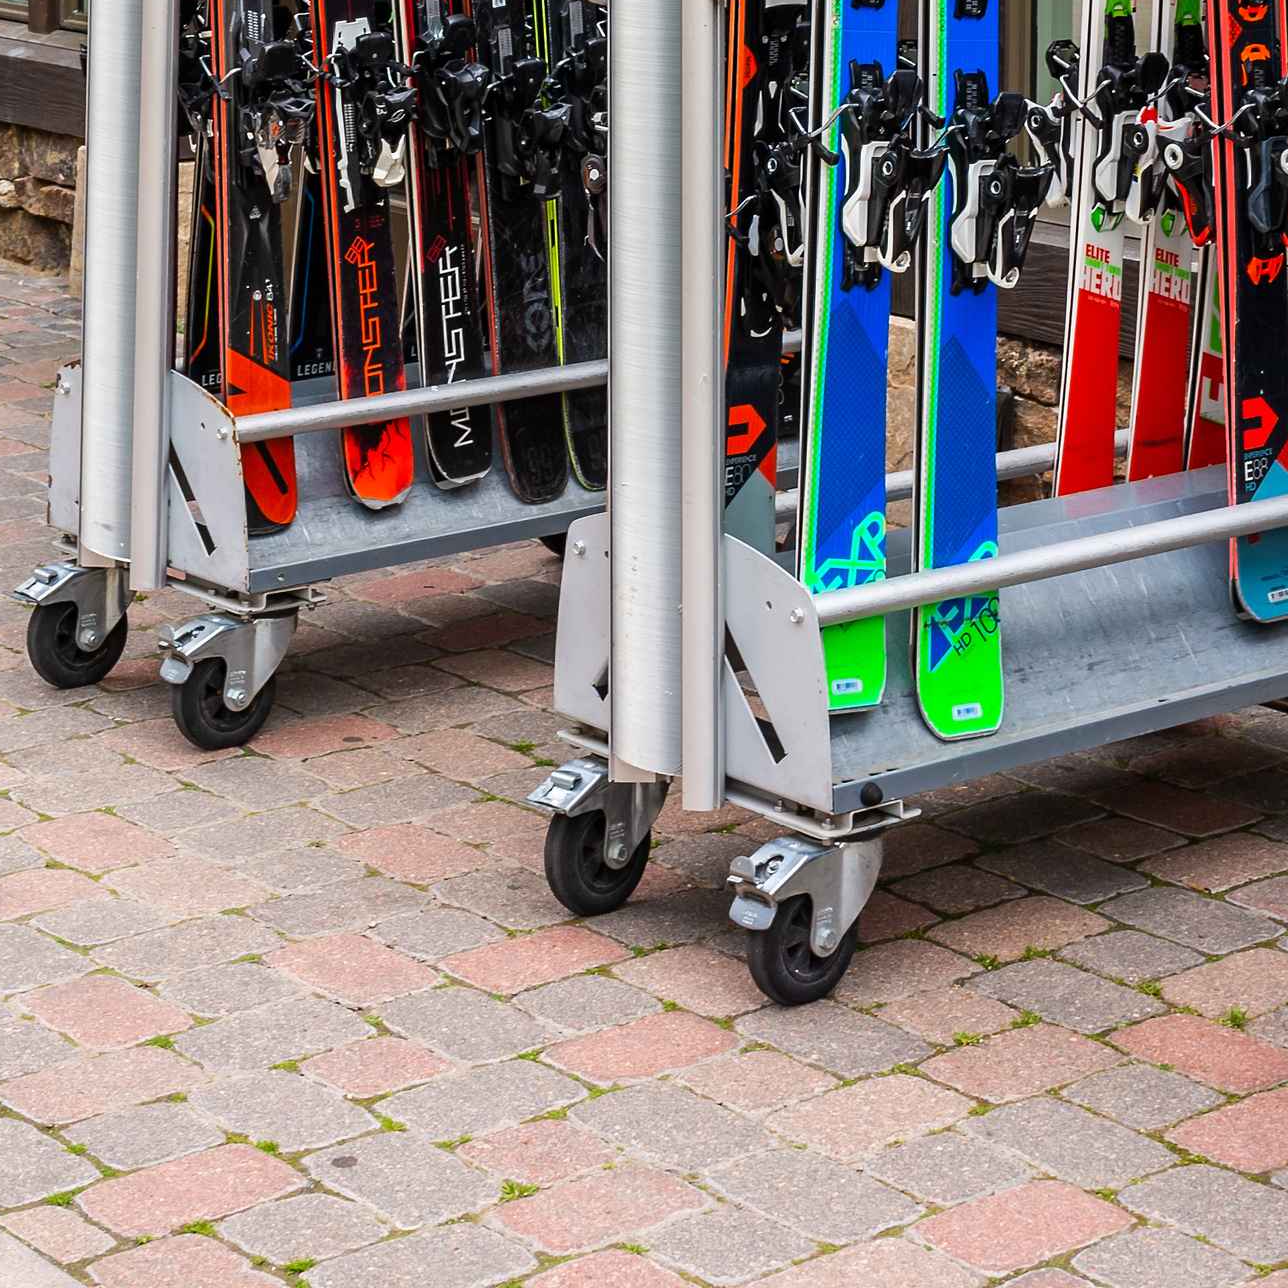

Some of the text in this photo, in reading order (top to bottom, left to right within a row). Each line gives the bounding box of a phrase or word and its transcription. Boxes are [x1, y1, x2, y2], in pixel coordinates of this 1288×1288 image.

[1085, 243, 1111, 264] ELITE
[1155, 247, 1180, 268] ELITE
[358, 241, 384, 397] ONSTER
[265, 301, 275, 365] IKONIC
[296, 363, 336, 377] LEGEN
[952, 632, 973, 657] HD
